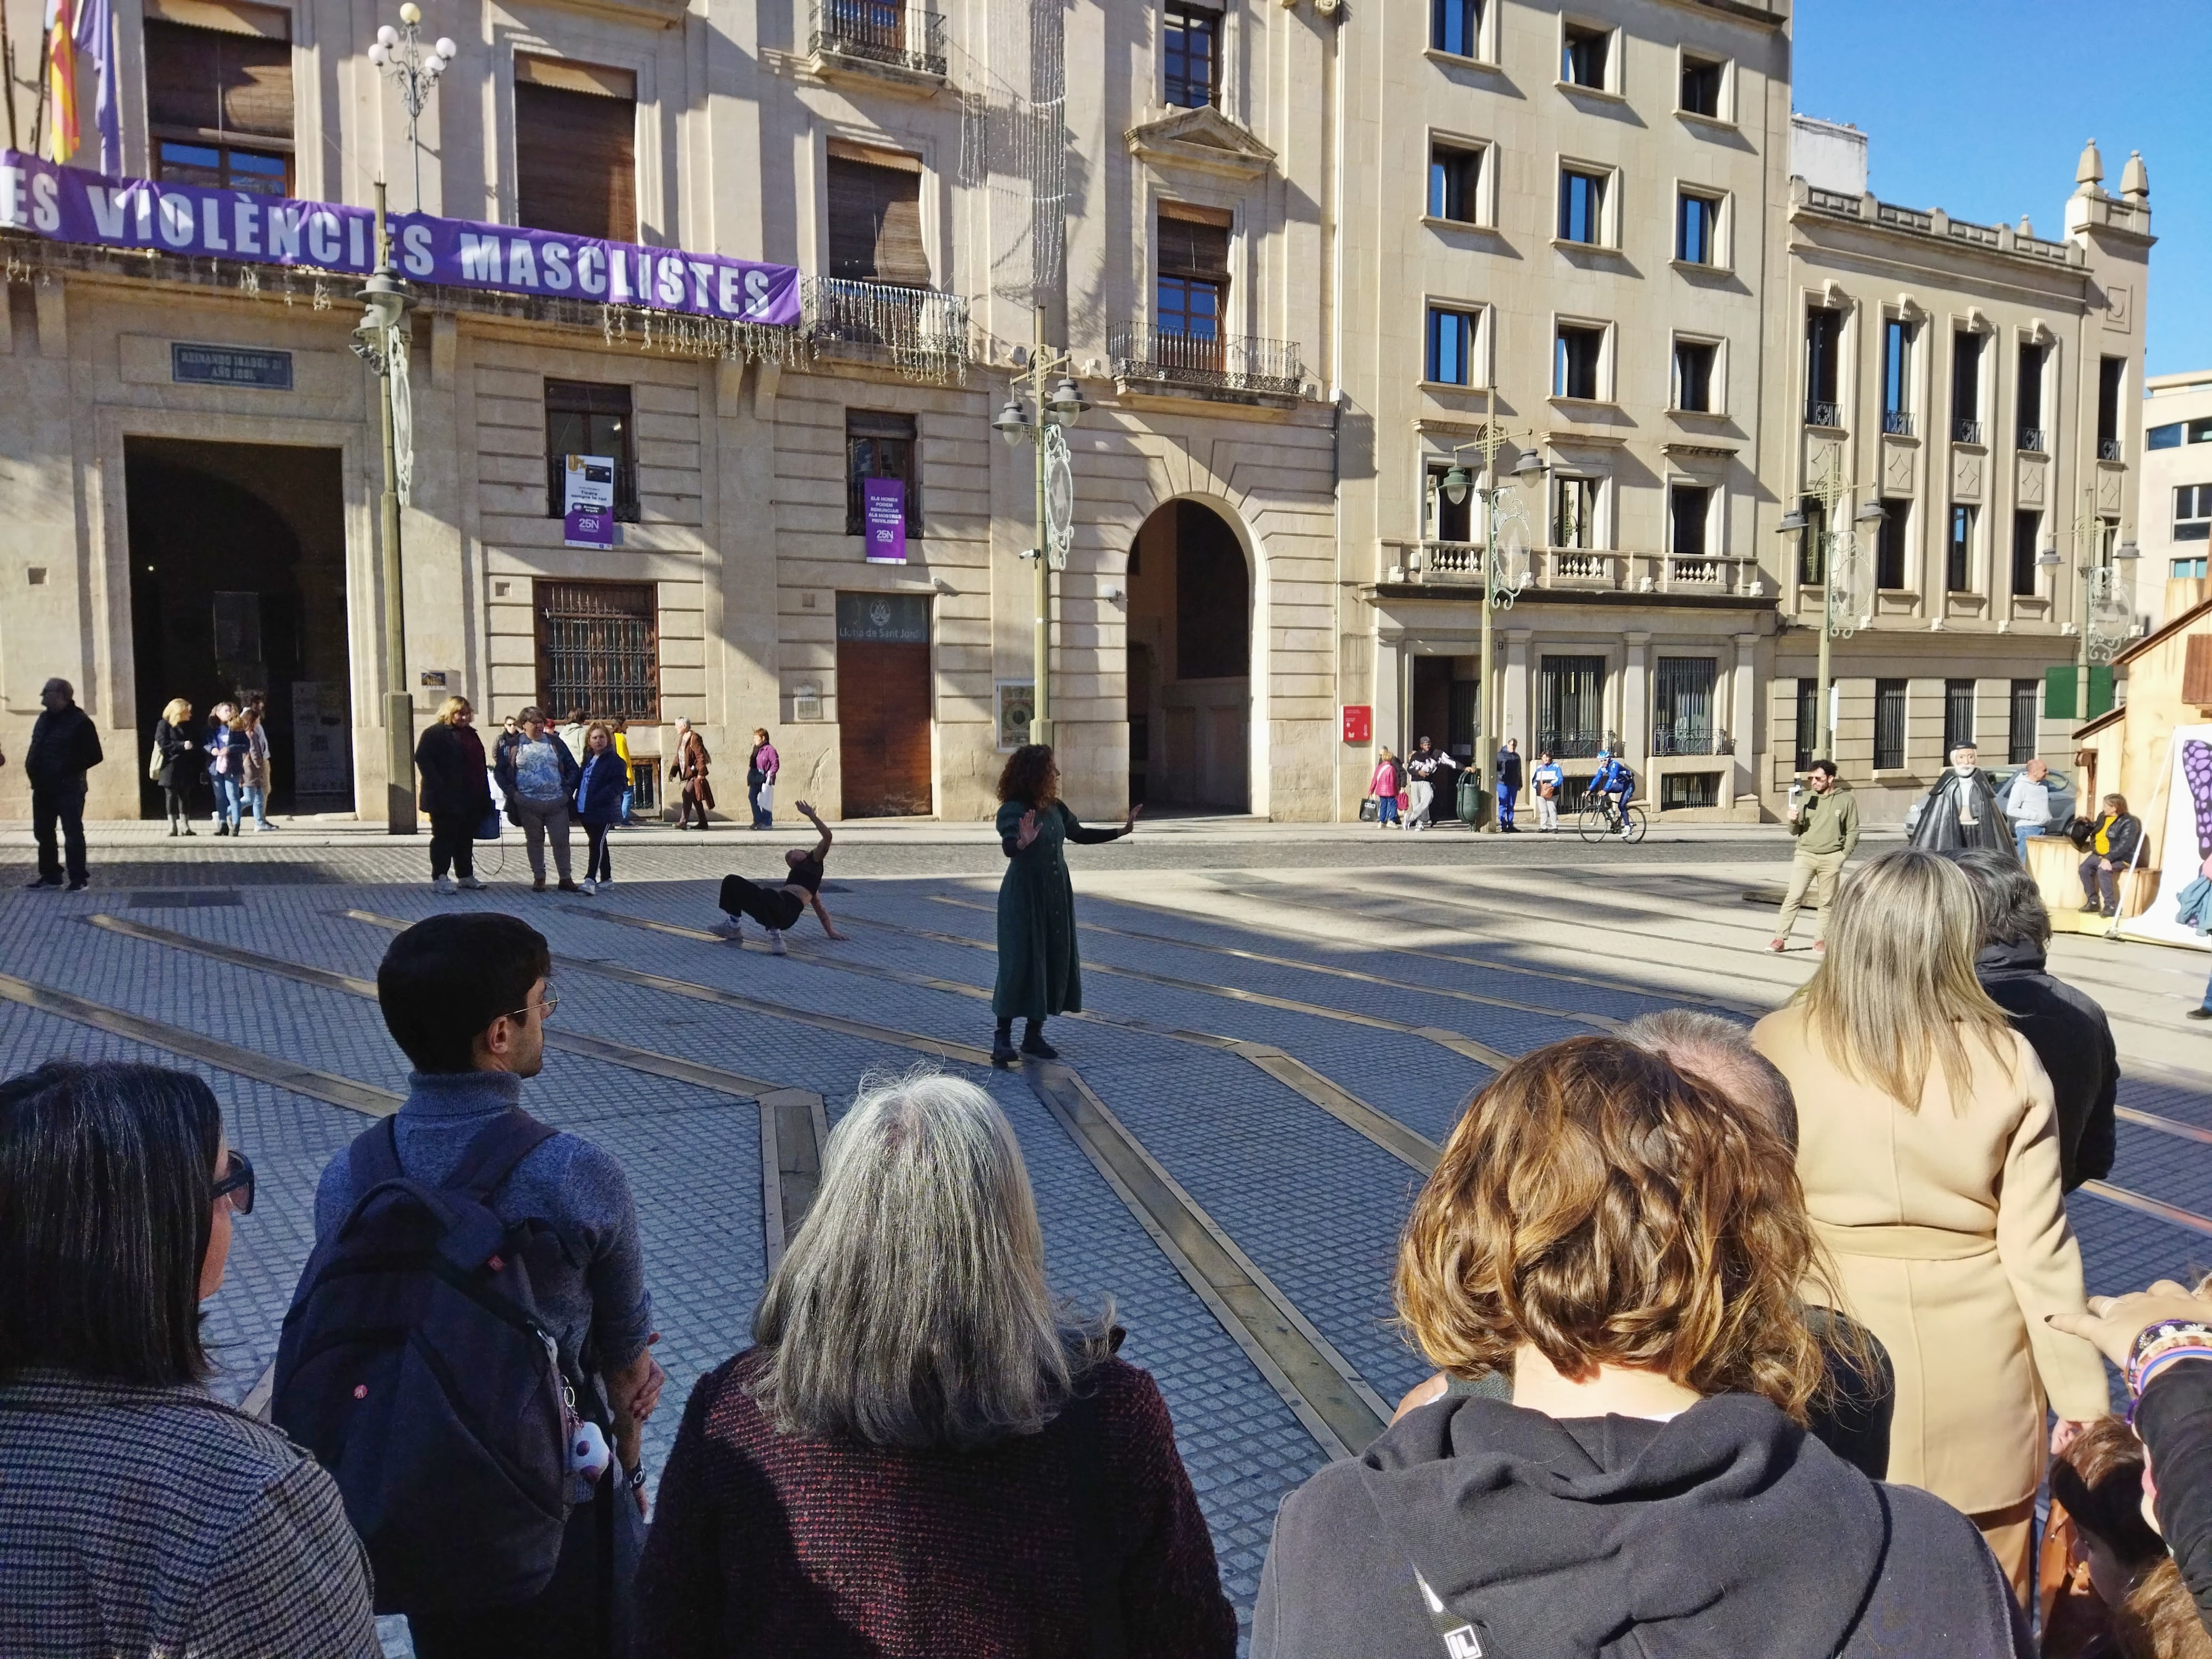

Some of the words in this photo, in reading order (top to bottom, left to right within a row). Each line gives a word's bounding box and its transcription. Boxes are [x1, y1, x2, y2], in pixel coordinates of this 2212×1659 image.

[460, 233, 769, 317] MASCLISTES
[579, 518, 599, 529] 25N
[877, 530, 894, 539] 25N
[866, 628, 877, 637] de
[879, 628, 899, 637] Sant
